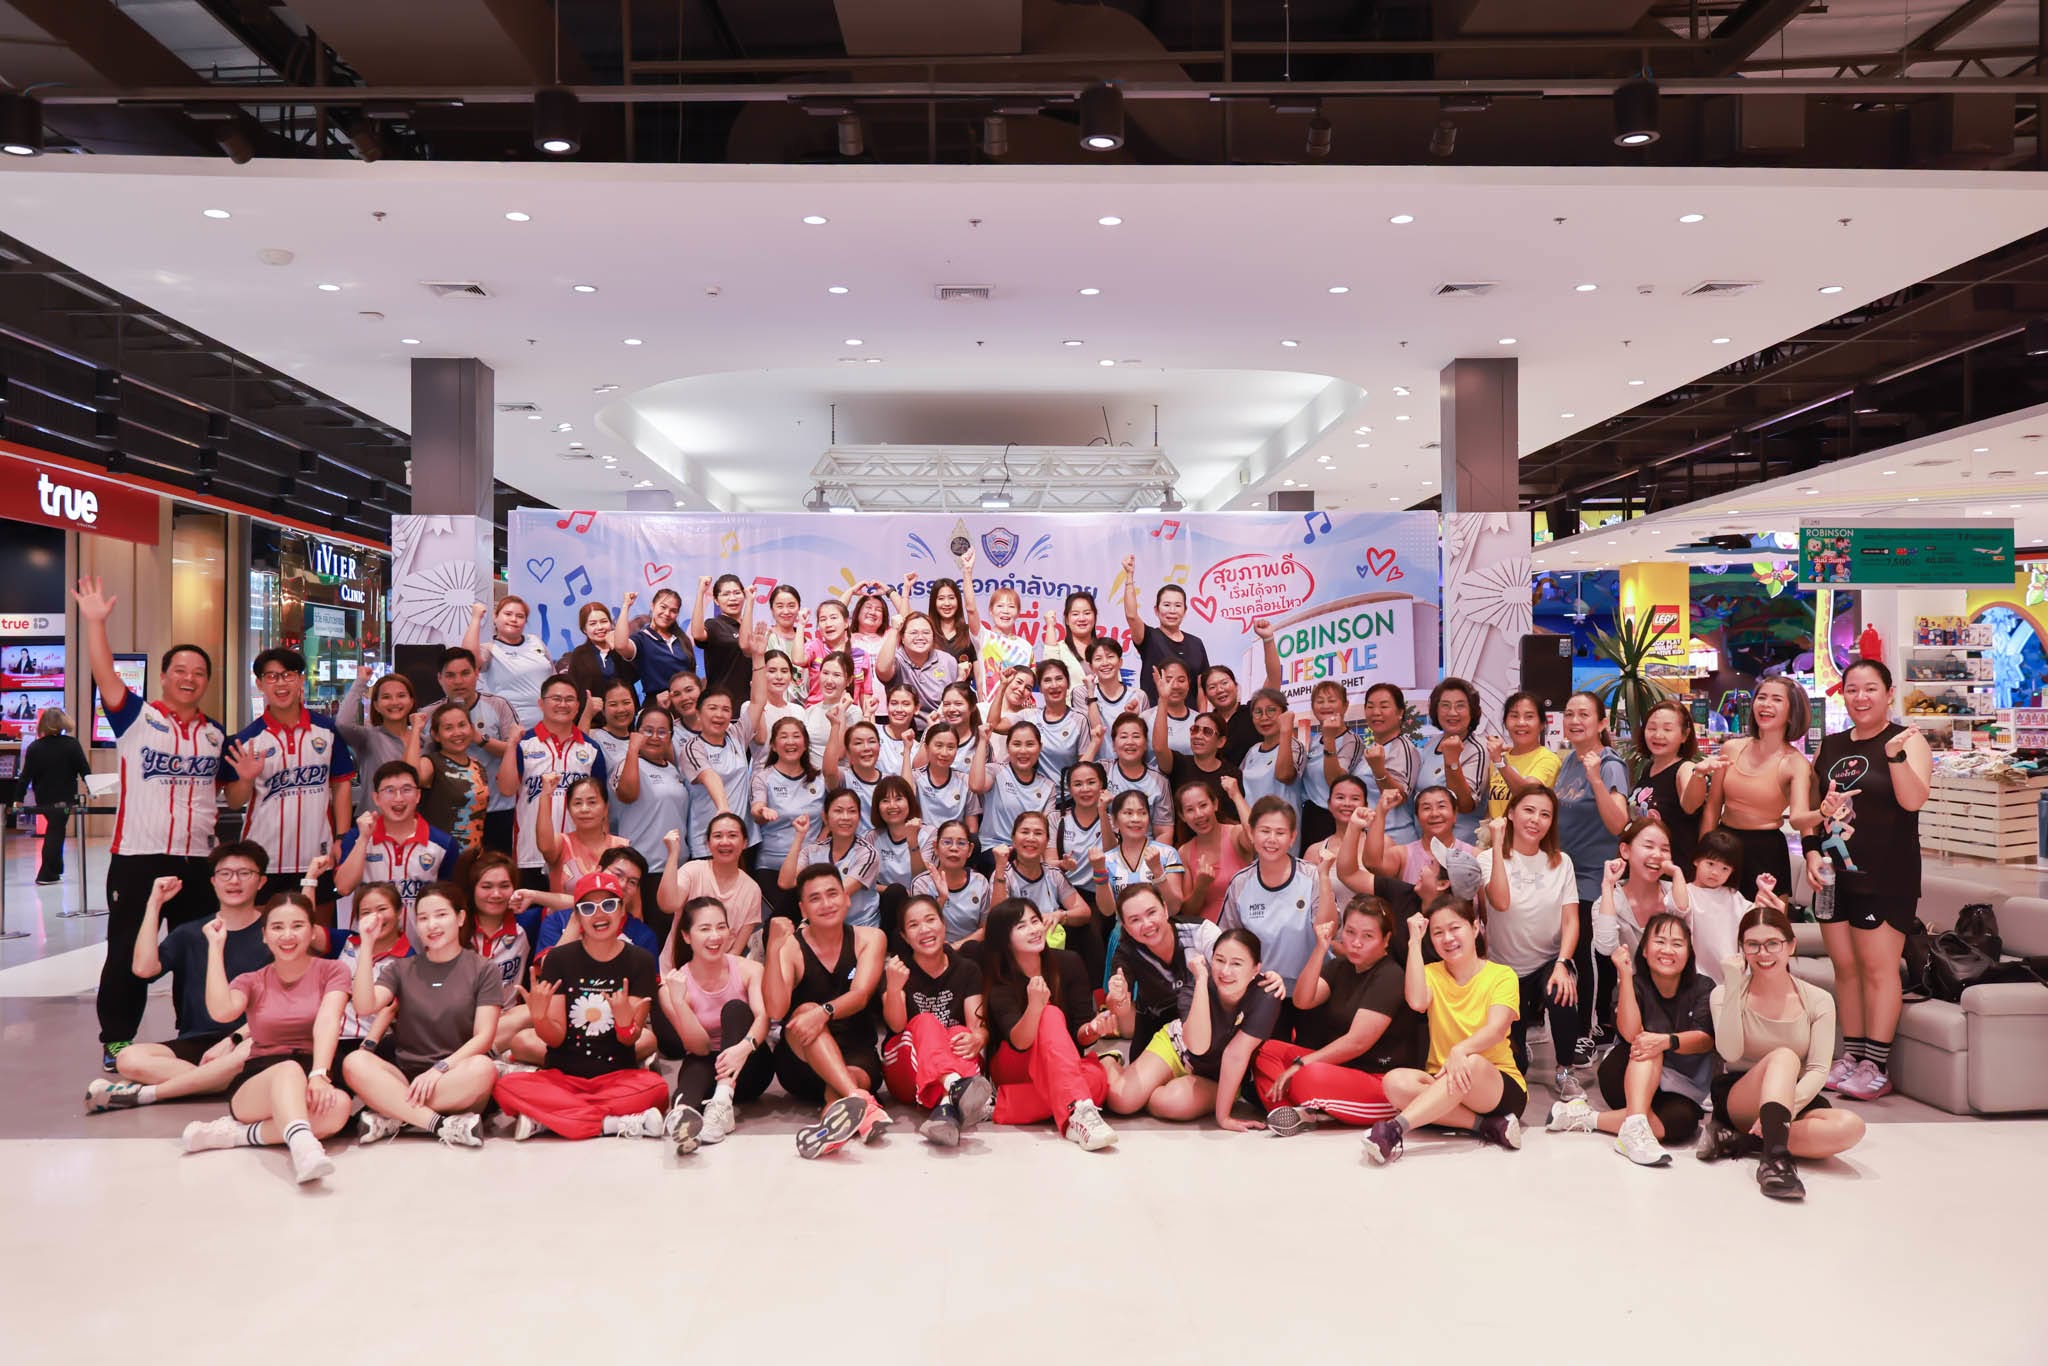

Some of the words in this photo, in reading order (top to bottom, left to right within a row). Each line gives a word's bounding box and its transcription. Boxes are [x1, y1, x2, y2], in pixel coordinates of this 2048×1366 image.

[38, 473, 98, 524] true
[1806, 529, 1854, 537] ROBINSON
[1213, 553, 1295, 592] สุขภาพดี
[1229, 582, 1287, 600] เริ่มได้จาก
[1220, 595, 1301, 617] การเคลื่อนไหว
[1, 618, 29, 629] true
[1277, 609, 1394, 659] OBINSON
[1280, 644, 1378, 686] LIFESTYLE
[141, 746, 182, 774] YEC
[266, 769, 288, 790] EC
